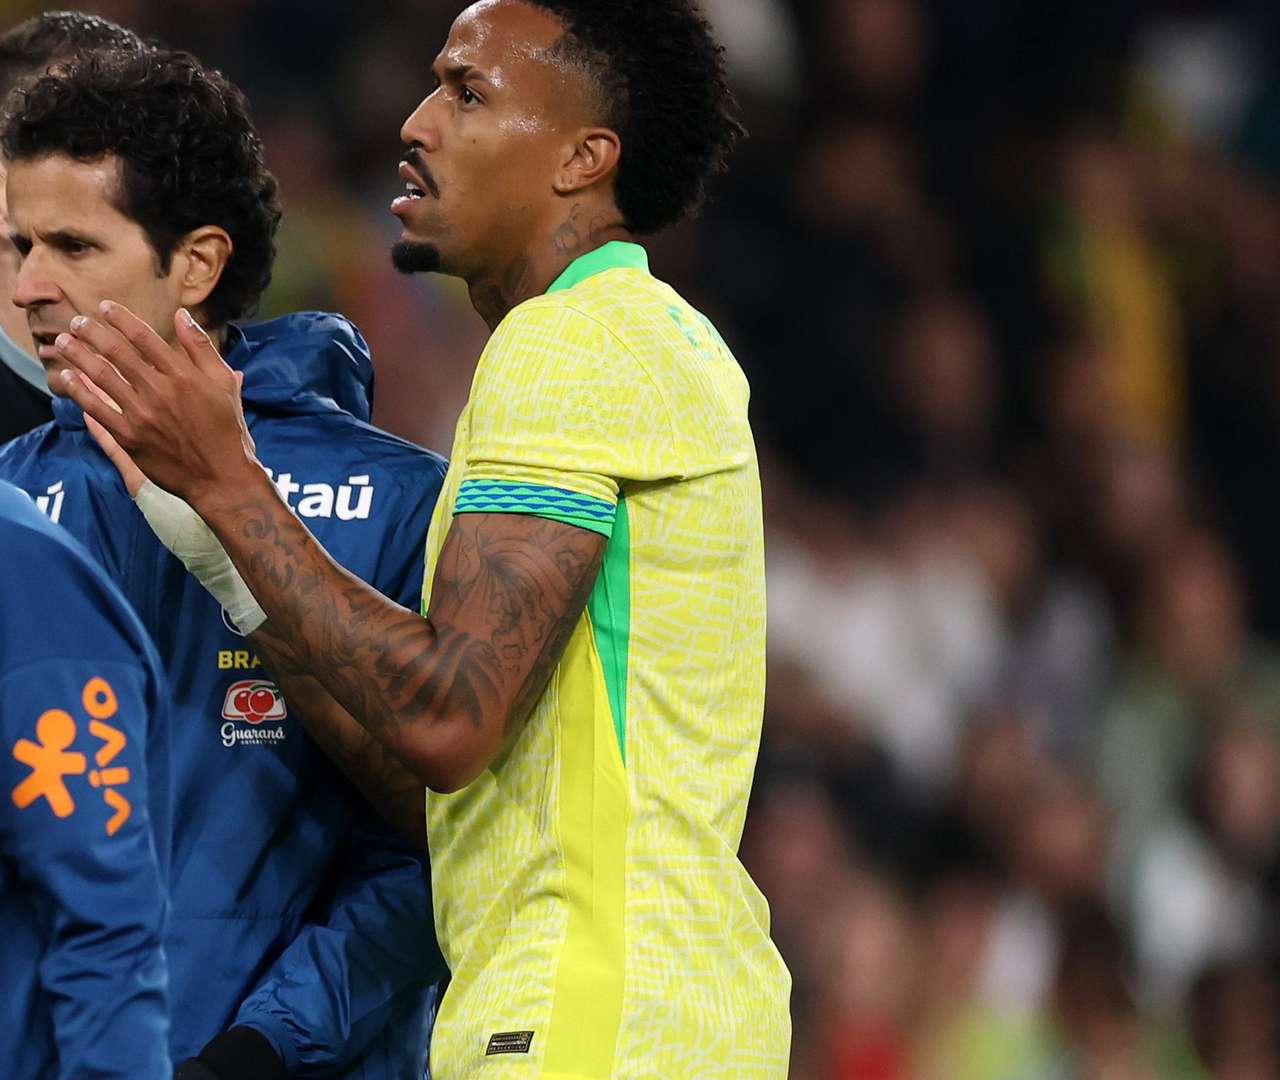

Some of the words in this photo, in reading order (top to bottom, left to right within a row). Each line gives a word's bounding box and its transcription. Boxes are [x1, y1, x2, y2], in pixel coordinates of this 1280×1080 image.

[217, 650, 262, 670] BRA
[221, 722, 286, 748] Guaraná
[81, 676, 132, 837] vivo
